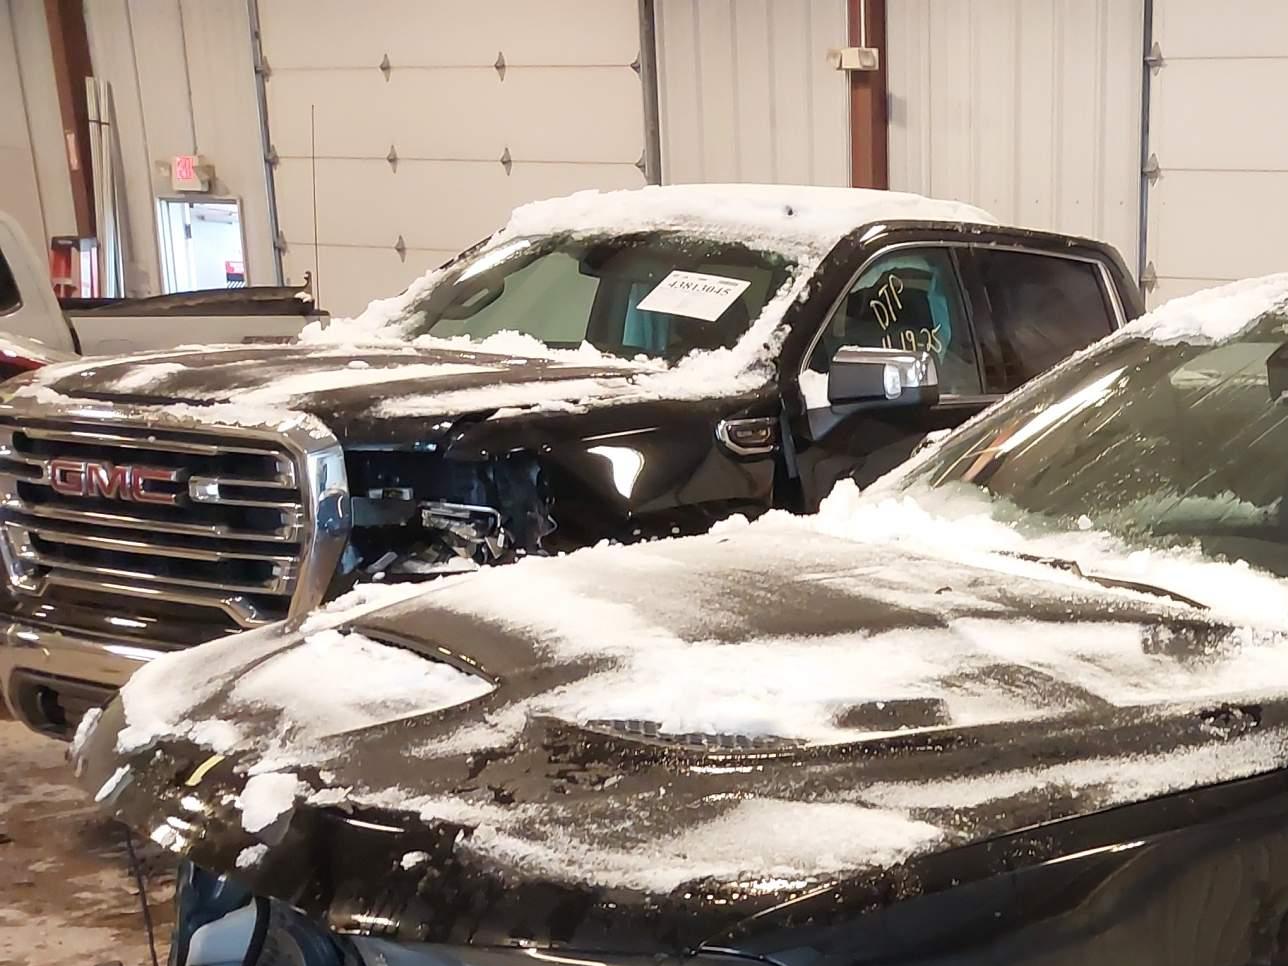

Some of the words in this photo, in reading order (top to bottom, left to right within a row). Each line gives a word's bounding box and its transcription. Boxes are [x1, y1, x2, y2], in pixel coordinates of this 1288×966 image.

[870, 274, 904, 330] DTP
[882, 324, 942, 353] 1119-25
[49, 457, 177, 504] GMC
